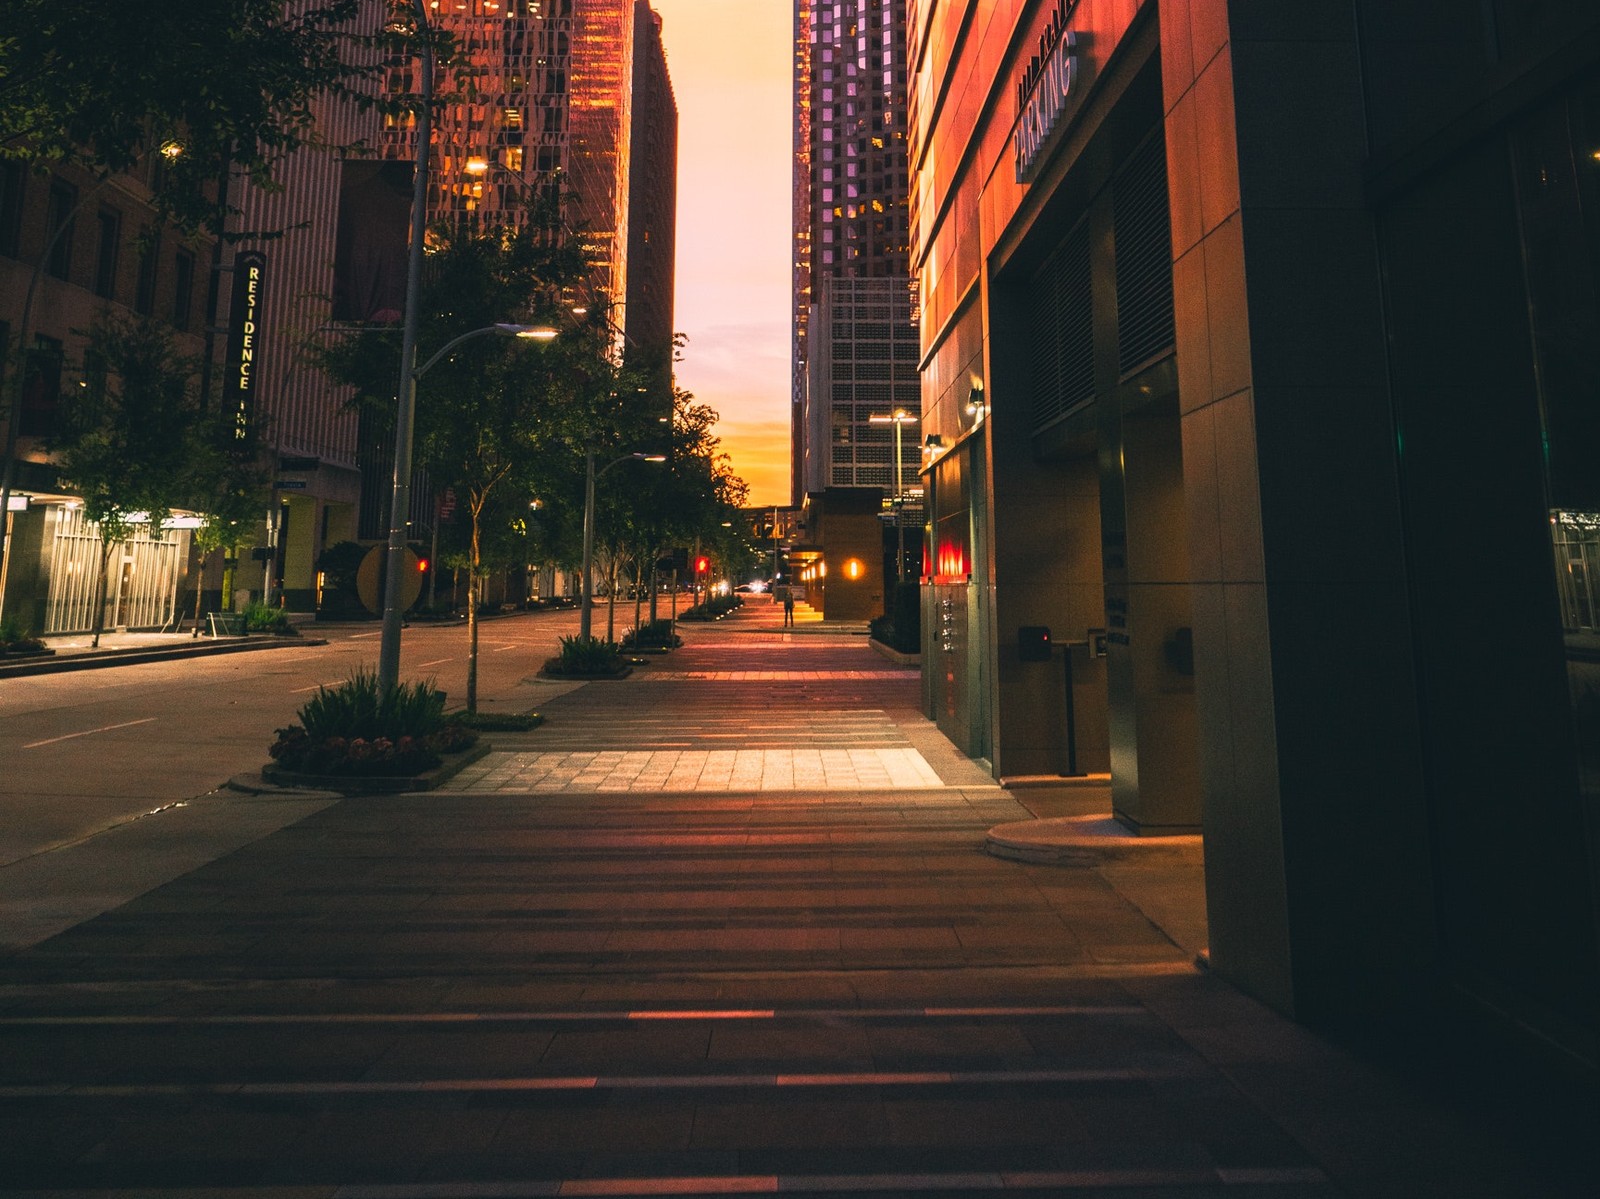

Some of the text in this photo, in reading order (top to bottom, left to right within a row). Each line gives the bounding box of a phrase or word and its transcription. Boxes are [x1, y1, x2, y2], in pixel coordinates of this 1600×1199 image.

[1012, 30, 1077, 180] PARKING
[239, 267, 259, 390] RESIDENCE
[235, 400, 247, 439] INN
